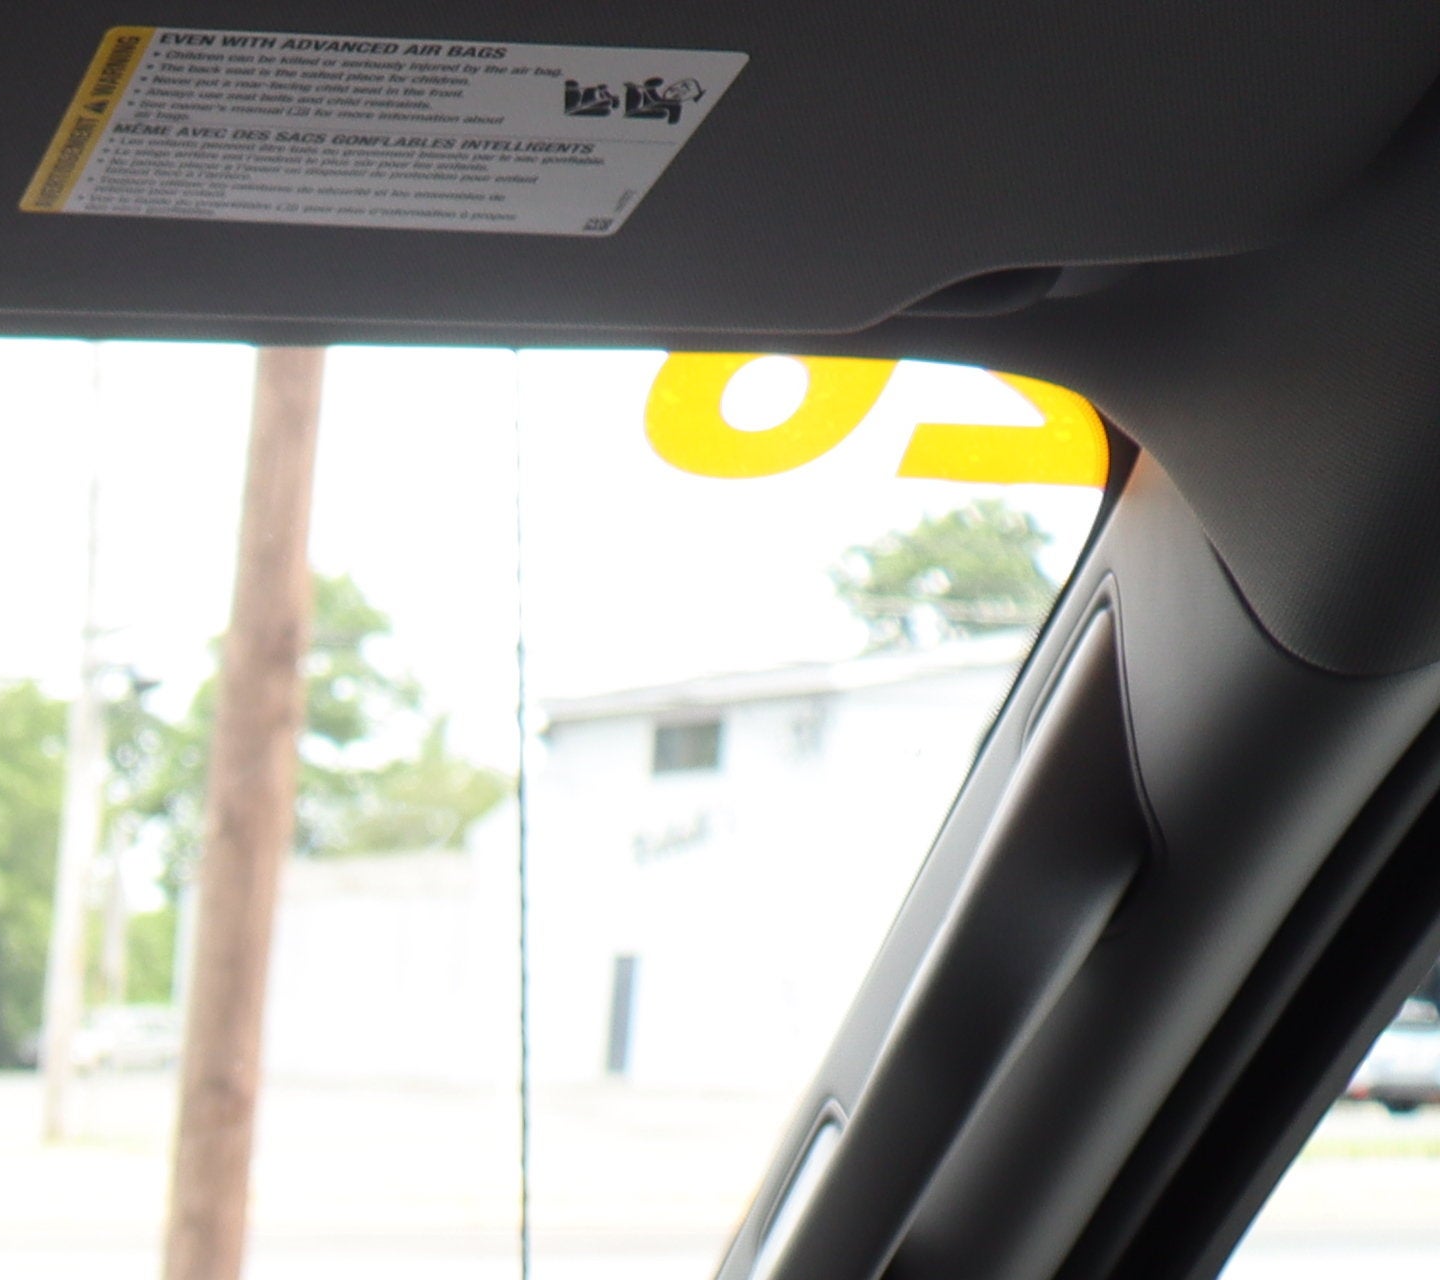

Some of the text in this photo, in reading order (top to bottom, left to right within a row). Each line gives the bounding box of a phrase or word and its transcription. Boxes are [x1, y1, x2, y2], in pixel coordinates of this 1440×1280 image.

[160, 32, 508, 59] EVEN WITH ADVANCED AIR BAGS
[176, 126, 228, 138] AVEC
[232, 129, 270, 140] DES
[275, 131, 326, 144] SACS
[332, 134, 456, 148] GONFLABLES
[460, 140, 596, 154] INTELLIGENTS
